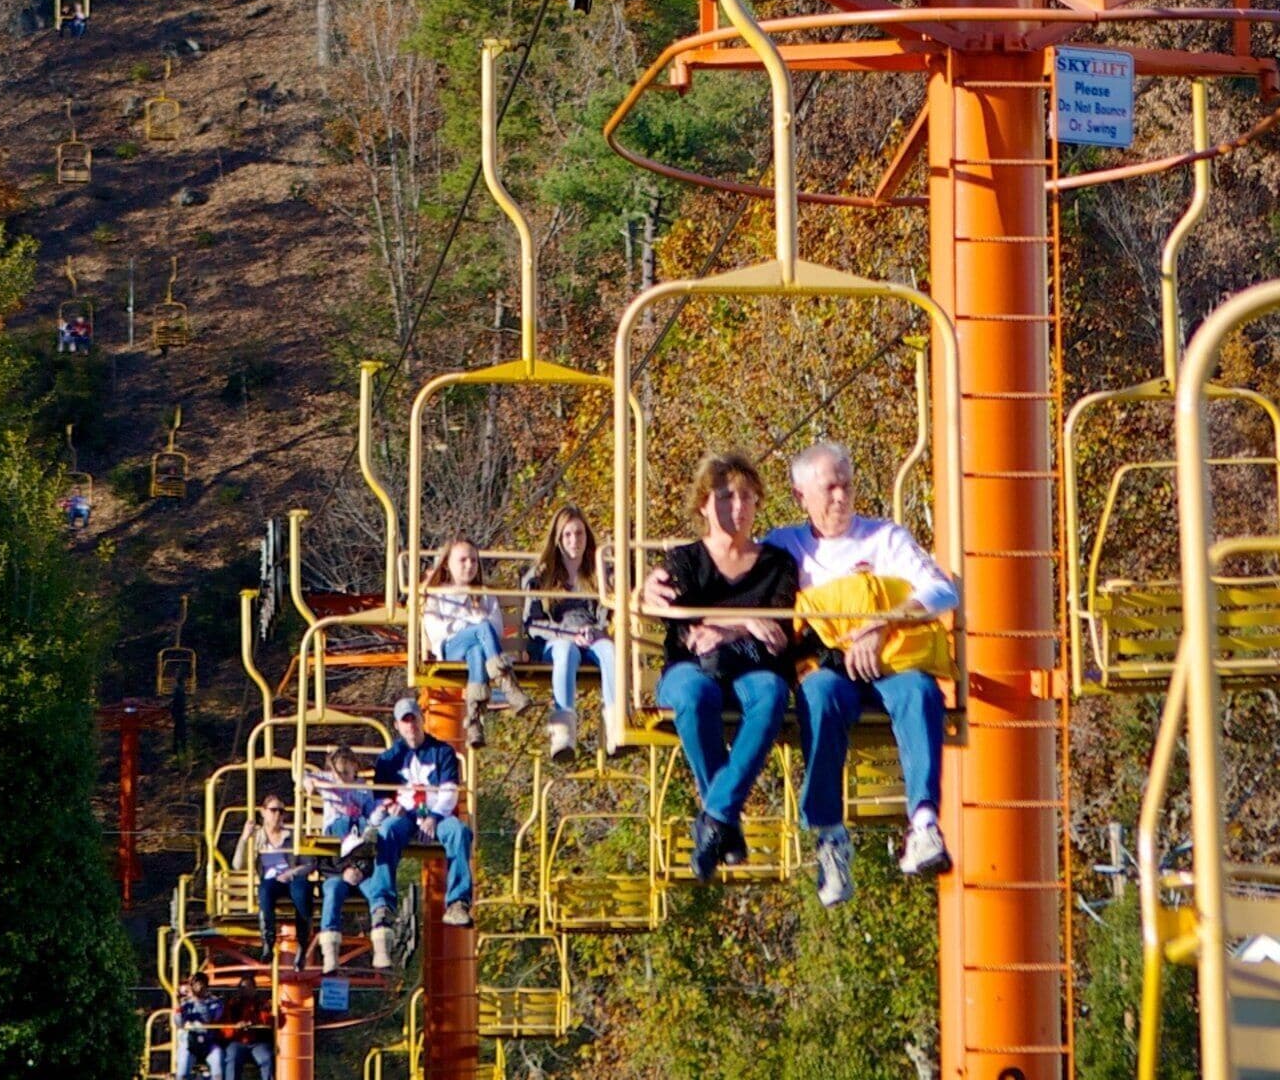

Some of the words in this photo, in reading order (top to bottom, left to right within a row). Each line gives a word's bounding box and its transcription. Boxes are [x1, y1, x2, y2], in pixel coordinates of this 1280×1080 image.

[1057, 56, 1128, 77] SKYLIFT
[1075, 81, 1110, 97] Please
[1058, 99, 1071, 112] Do
[1075, 101, 1091, 113] Not
[1095, 102, 1127, 117] Bounce
[1069, 119, 1082, 131] Or
[1087, 120, 1117, 138] Swing
